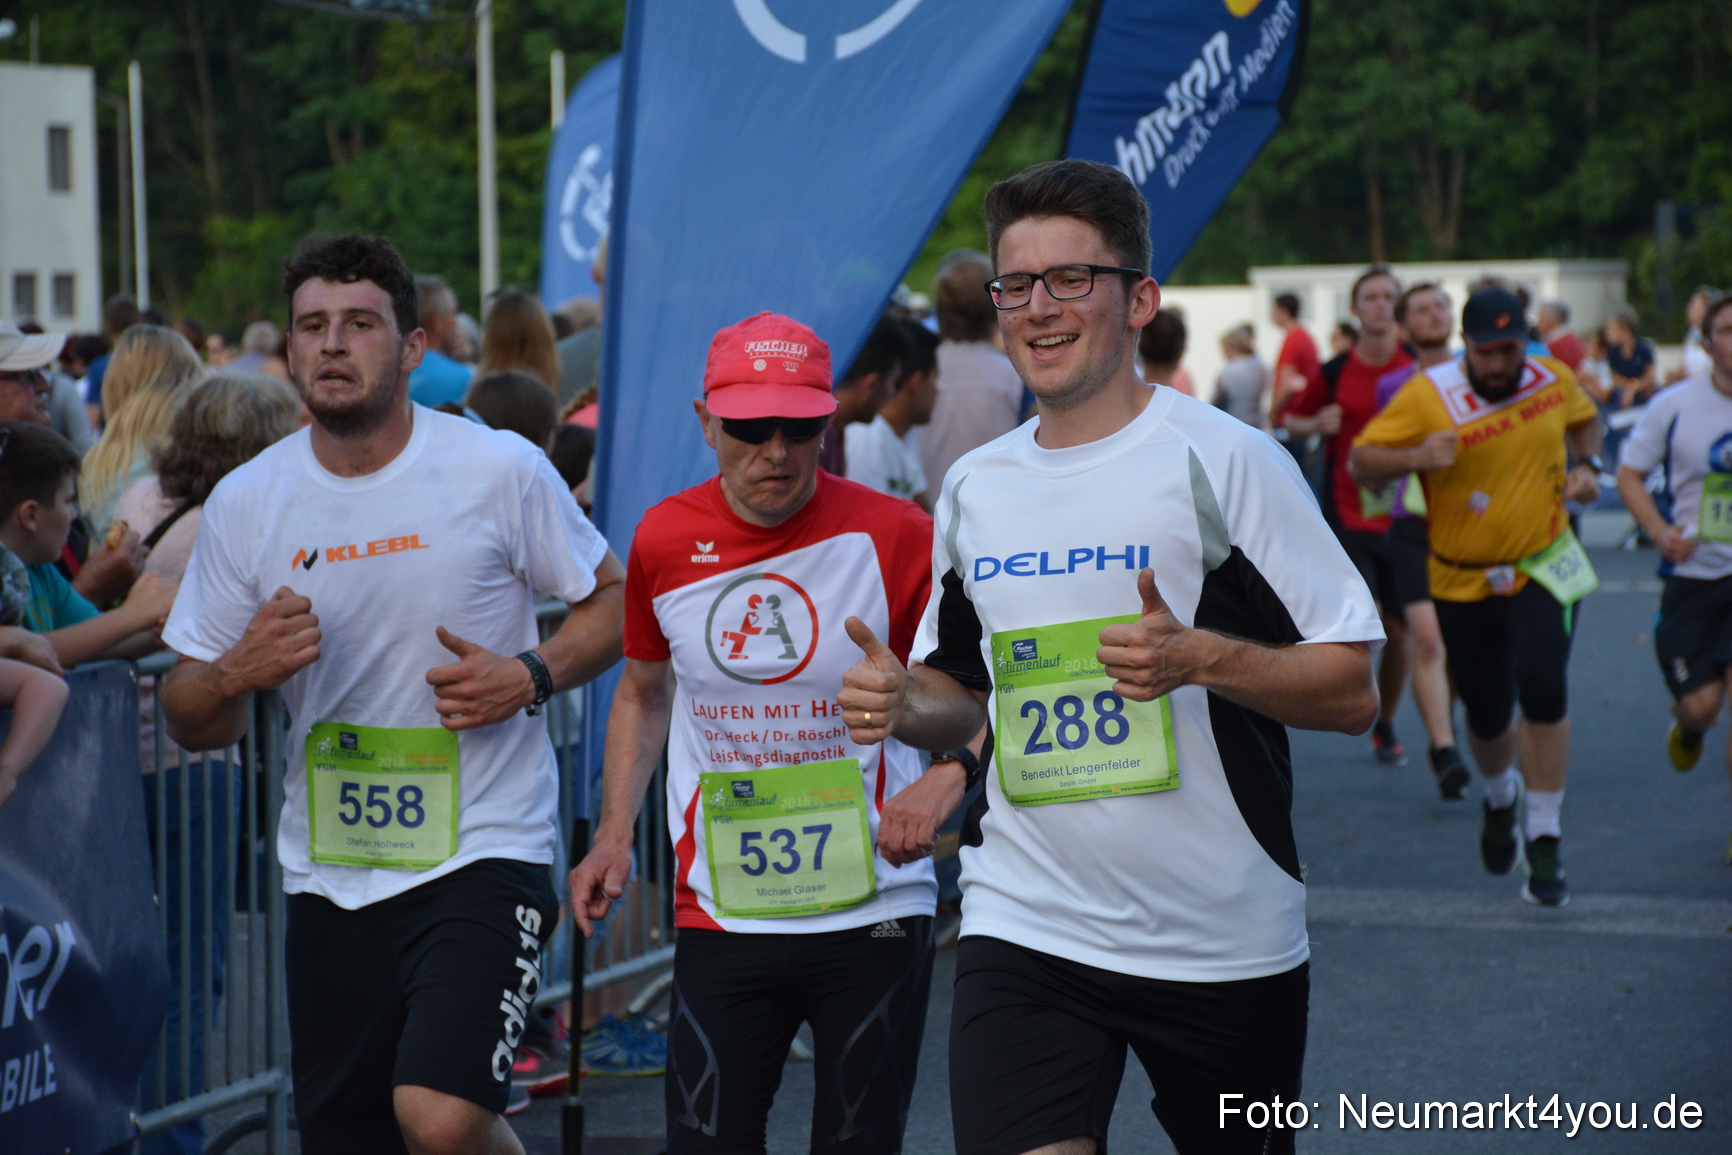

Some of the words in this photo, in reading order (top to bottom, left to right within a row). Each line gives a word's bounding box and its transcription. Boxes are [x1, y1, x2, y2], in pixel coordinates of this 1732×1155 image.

[1163, 115, 1212, 189] Druck
[1238, 0, 1296, 94] Medien
[1115, 30, 1232, 186] hmann
[744, 340, 808, 355] FISCHER
[1461, 417, 1514, 449] MAX
[325, 534, 430, 564] KLEBL
[691, 553, 720, 563] erima
[974, 545, 1150, 582] DELPHI
[1005, 653, 1062, 673] firmenlauf
[1064, 658, 1097, 673] 2016
[692, 697, 754, 720] LAUFEN
[764, 704, 801, 719] MIT
[811, 700, 841, 718] HE
[1020, 690, 1130, 756] 288
[705, 730, 724, 741] Dr.
[726, 731, 759, 743] Heck
[762, 730, 769, 744] /
[773, 730, 794, 742] Dr.
[798, 726, 847, 741] Röschl
[330, 746, 376, 761] firmenlauf
[710, 745, 846, 767] Leistungsdiagnostik
[1021, 765, 1064, 781] Benedikt
[1066, 758, 1142, 776] Lengenfelder
[1059, 780, 1077, 789] Delphi
[1078, 777, 1097, 786] GmbH
[338, 781, 426, 829] 558
[725, 793, 777, 809] firmenlauf
[780, 796, 811, 809] 2016
[346, 837, 372, 848] Stefan
[740, 823, 833, 877] 537
[756, 887, 792, 897] Michael
[794, 883, 827, 895] Glaser
[871, 927, 906, 938] adidas
[492, 904, 542, 1082] adidas
[0, 1043, 57, 1114] BILE
